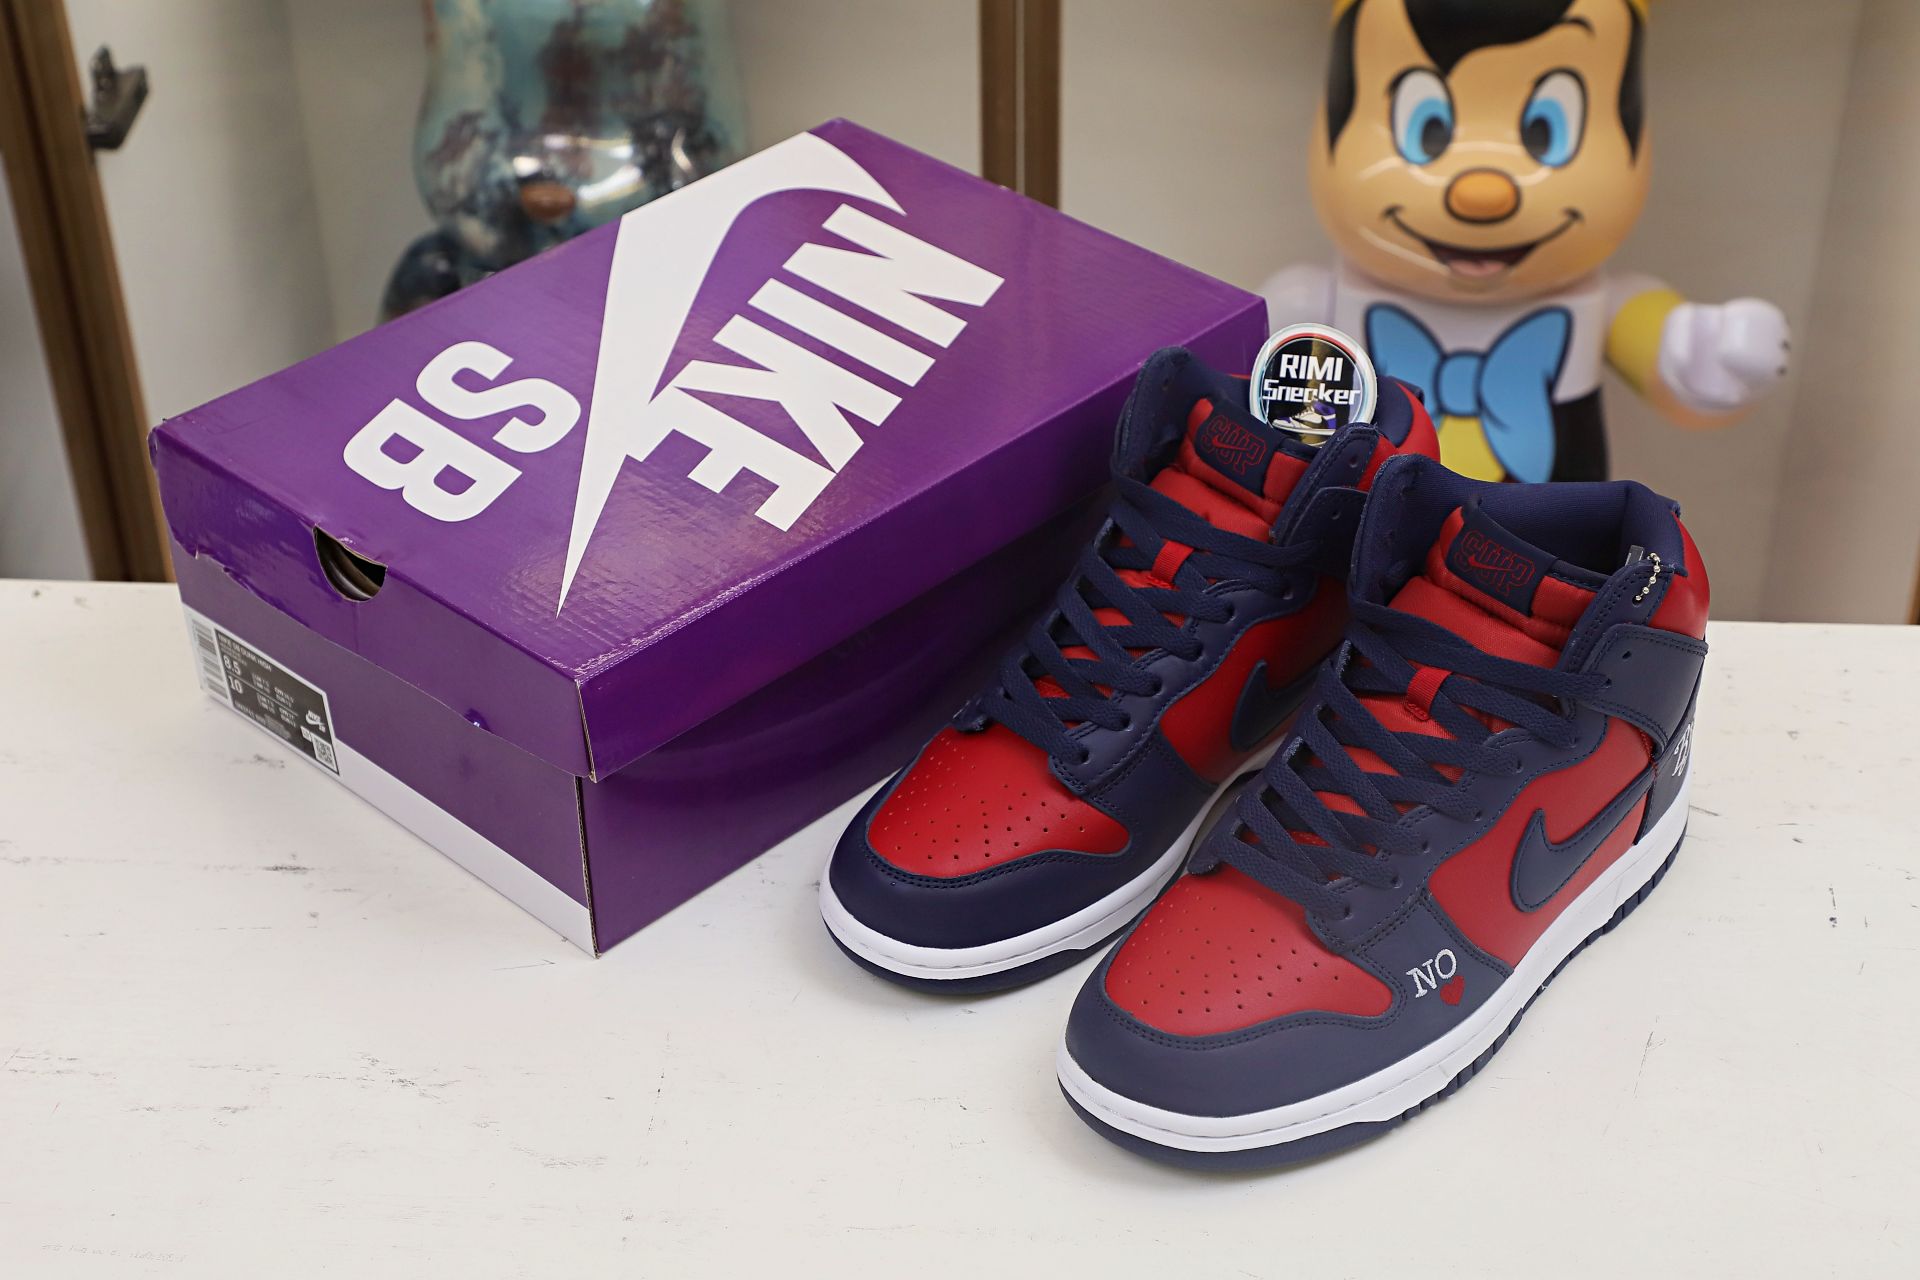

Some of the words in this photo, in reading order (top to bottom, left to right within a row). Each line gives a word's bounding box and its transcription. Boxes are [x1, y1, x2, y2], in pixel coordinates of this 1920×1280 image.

[627, 203, 1005, 532] NIKE
[1280, 353, 1343, 381] RIMI
[343, 341, 581, 522] SB
[223, 654, 242, 676] 8.5
[228, 675, 244, 694] 10
[1405, 948, 1457, 998] NO
